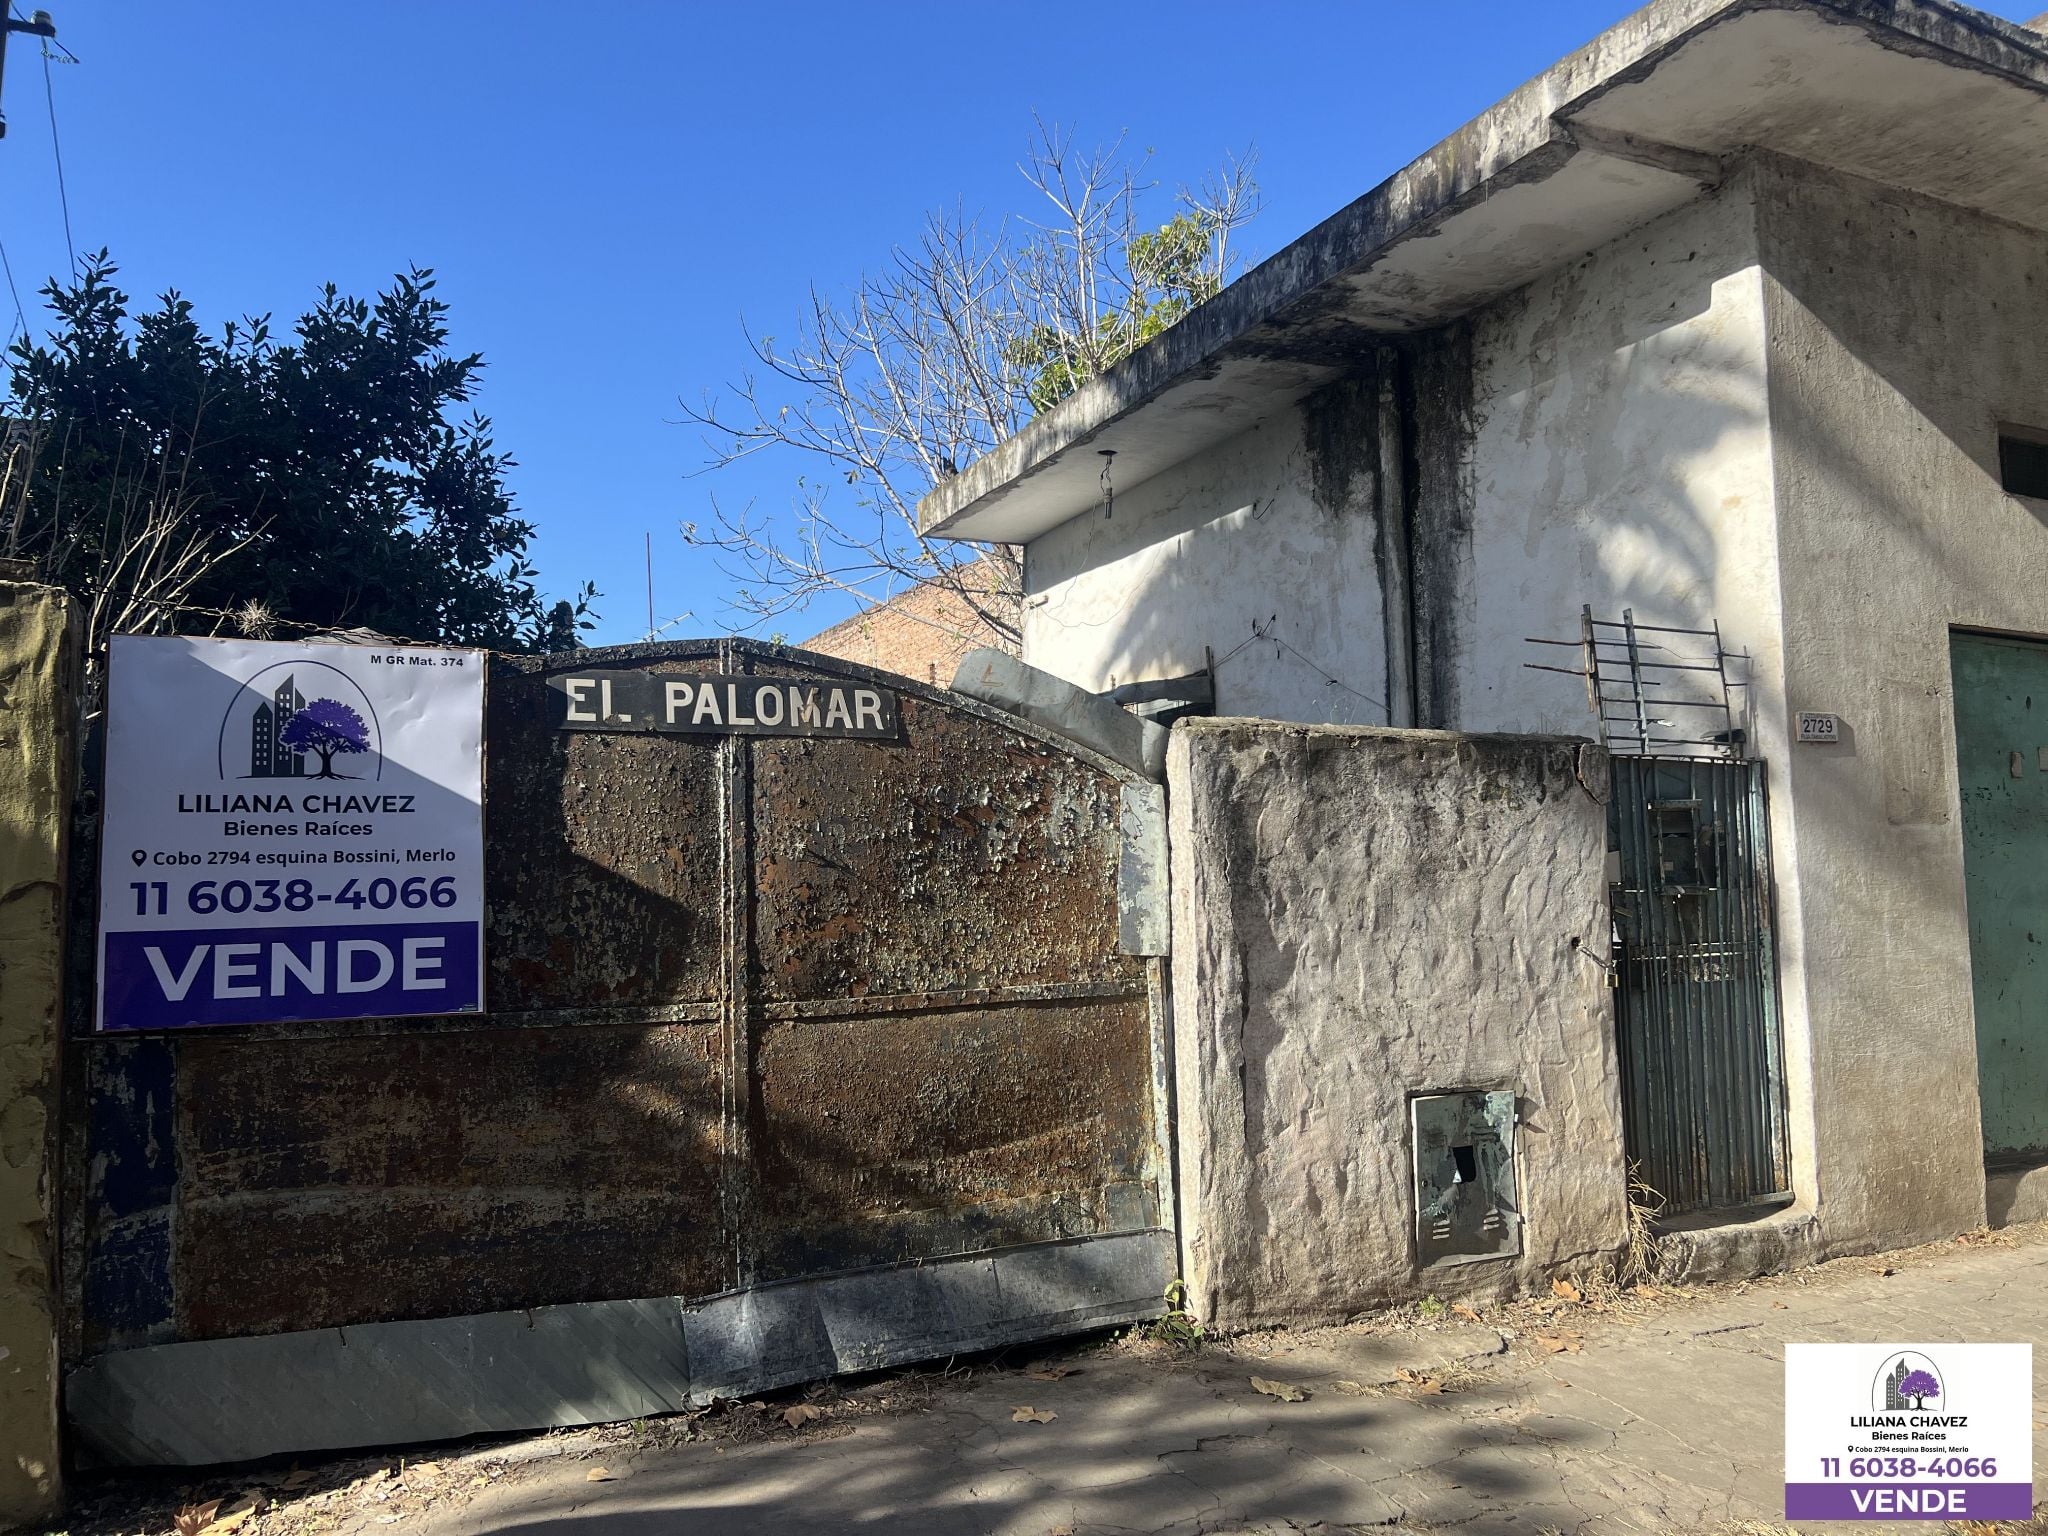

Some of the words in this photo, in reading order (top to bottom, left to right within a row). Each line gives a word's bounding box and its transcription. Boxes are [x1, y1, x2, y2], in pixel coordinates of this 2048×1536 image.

[370, 654, 382, 664] M
[386, 655, 405, 665] GR
[409, 656, 437, 666] Mat.
[440, 657, 464, 667] 374
[565, 678, 632, 723] EL
[665, 681, 884, 730] PALOMAR
[1803, 719, 1833, 733] 2729
[178, 794, 295, 813] LILIANA
[302, 794, 416, 814] CHAVEZ
[224, 819, 299, 836] Bienes
[305, 820, 373, 836] Raíces
[153, 851, 202, 866] Cobo
[207, 851, 251, 865] 2794
[256, 850, 328, 867] esquina
[333, 849, 401, 865] Bossini,
[406, 848, 456, 862] Merlo
[130, 881, 168, 915] 11
[188, 876, 457, 914] 6038-4066
[143, 936, 447, 1002] VENDE
